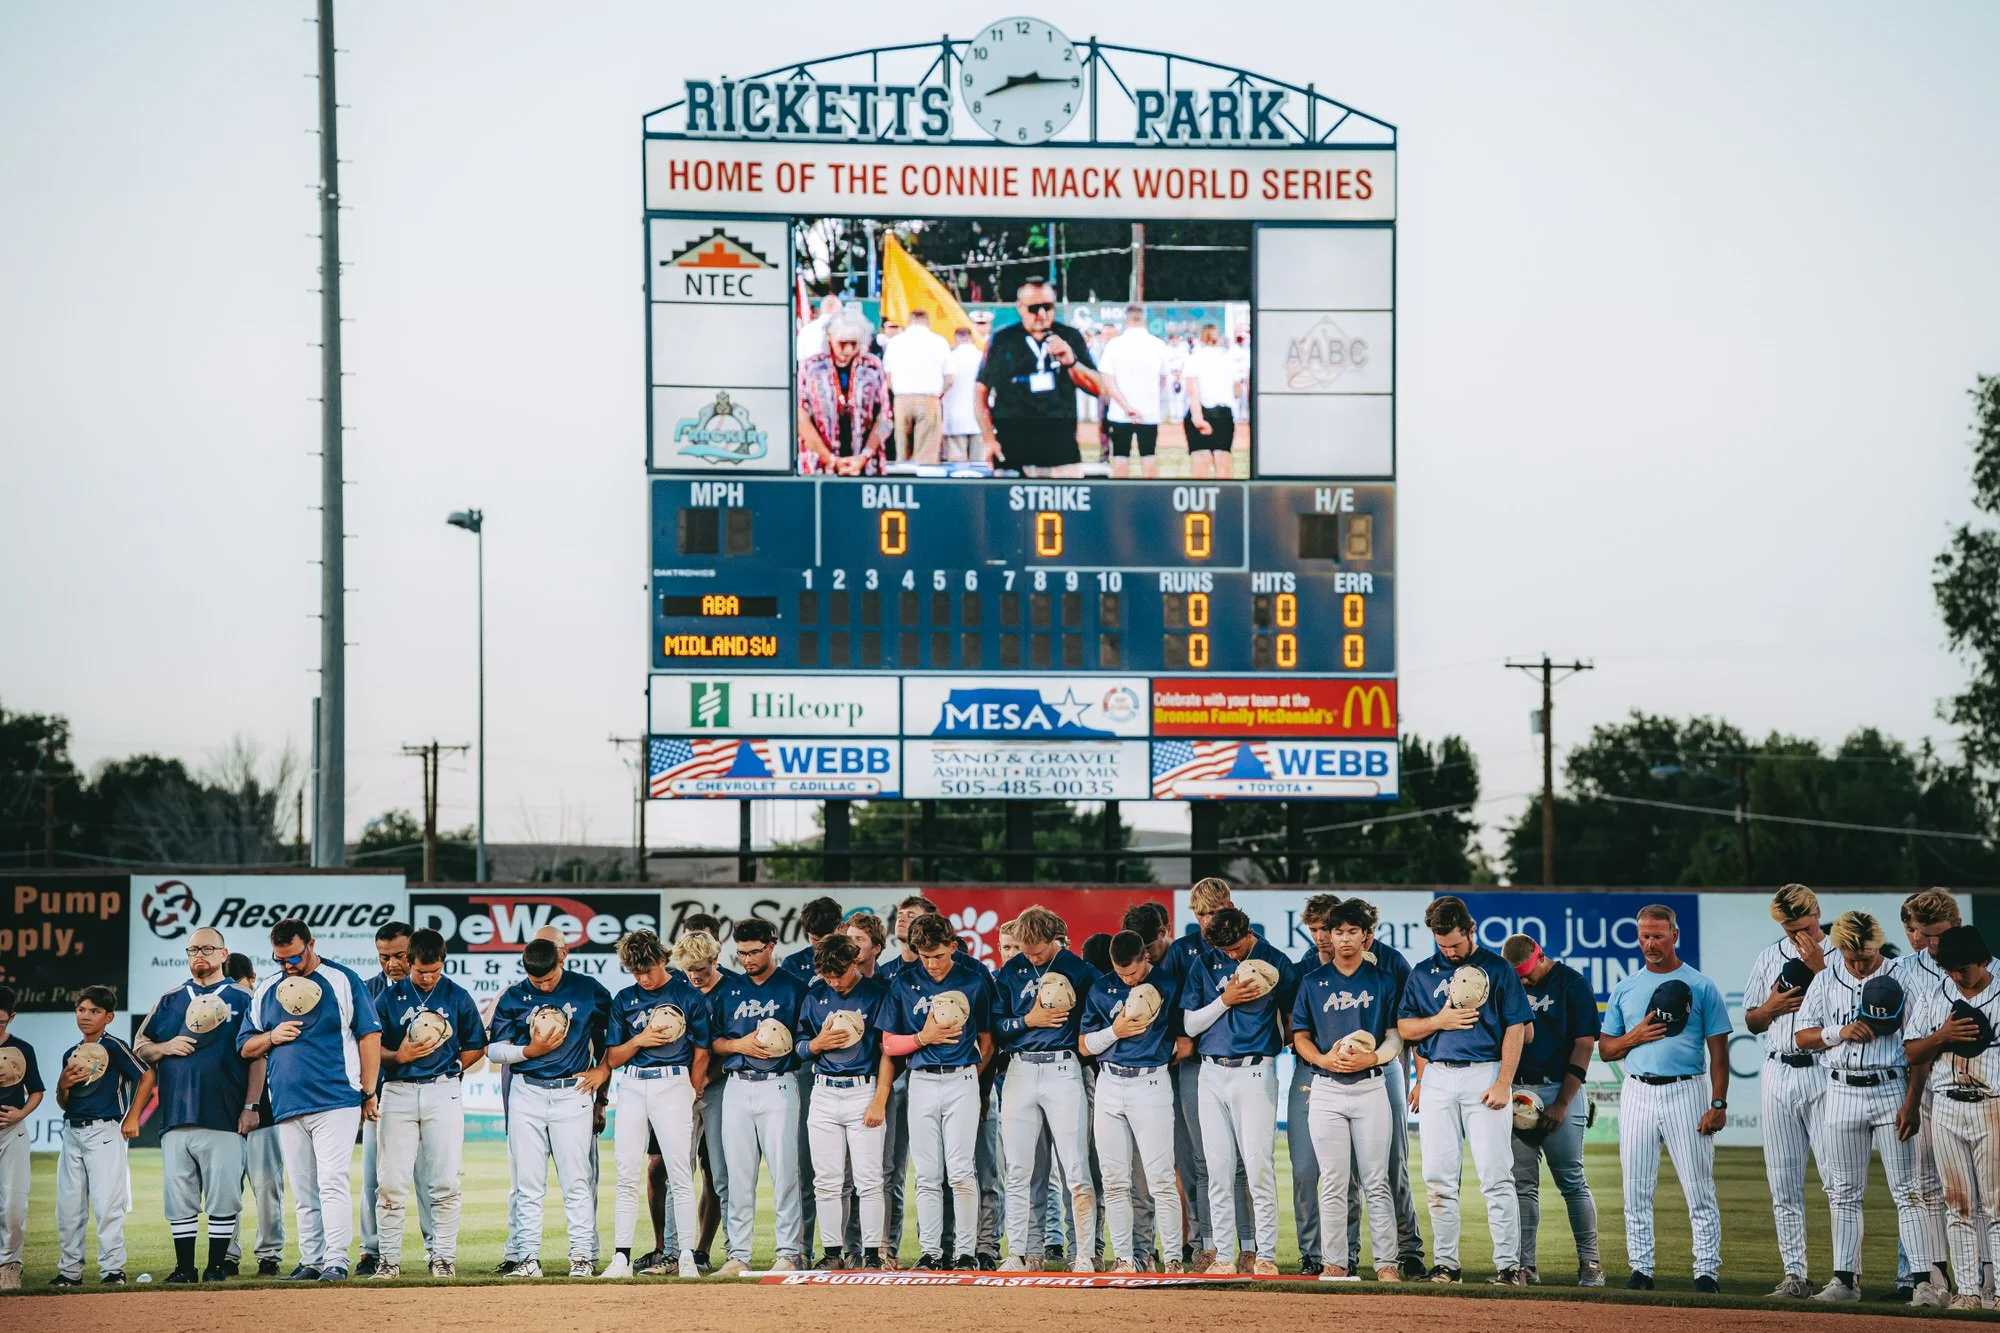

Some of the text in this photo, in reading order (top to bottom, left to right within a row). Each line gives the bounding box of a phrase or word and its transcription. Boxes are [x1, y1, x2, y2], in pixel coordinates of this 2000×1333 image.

[991, 29, 1003, 41] 11
[1015, 21, 1030, 34] 12
[1047, 30, 1053, 42] 1
[973, 47, 988, 60] 10
[1063, 48, 1072, 61] 2
[964, 74, 973, 87] 9
[685, 79, 1290, 145] RICKETTS PARK
[973, 101, 982, 114] 8
[1062, 102, 1071, 114] 4
[993, 119, 1001, 132] 7
[1018, 127, 1027, 140] 6
[1044, 120, 1053, 133] 5
[669, 159, 1373, 200] HOME OF THE CONNIE MACK WORLD SERIES
[686, 273, 753, 297] NTEC
[1285, 337, 1370, 368] AABC
[690, 482, 744, 507] MPH
[861, 484, 920, 510] BALL
[1009, 486, 1091, 512] STRIKE
[1172, 486, 1220, 512] OUT
[1314, 488, 1355, 513] H/E
[880, 510, 907, 555] 0
[1036, 511, 1063, 557] 0
[1184, 513, 1211, 558] 0
[802, 568, 1122, 593] 1 2 3 4 5 6 7 8 9 10
[1159, 572, 1213, 593] RUNS
[1252, 572, 1296, 593] HITS
[1334, 572, 1373, 593] ERR
[702, 594, 739, 616] ABA
[1187, 593, 1209, 628] 0
[1275, 593, 1297, 628] 0
[1343, 593, 1365, 628] 0
[1187, 633, 1209, 668] 0
[1275, 633, 1297, 669] 0
[1343, 634, 1365, 669] 0
[748, 692, 863, 728] Hilcorp
[1153, 692, 1310, 710] Celebrate with your team at the
[944, 703, 1053, 730] MESA
[1154, 708, 1334, 727] Bronson Family McDonald's
[777, 746, 891, 774] WEBB
[932, 752, 1121, 765] SAND & GRAVEL
[1278, 748, 1389, 777] WEBB
[932, 766, 1120, 778] ASPHALT READY MIX
[696, 781, 856, 791] CHEVROLET CADILLAC
[940, 779, 1114, 795] 505-485-0035
[1250, 783, 1302, 793] TOYOTA
[14, 885, 121, 920] Pump
[211, 897, 395, 928] Resource
[414, 904, 656, 944] DeWees
[1284, 909, 1419, 950] Kar
[486, 959, 502, 975] &
[472, 980, 499, 992] 705
[734, 999, 781, 1020] ABA
[1323, 989, 1375, 1013] ABA
